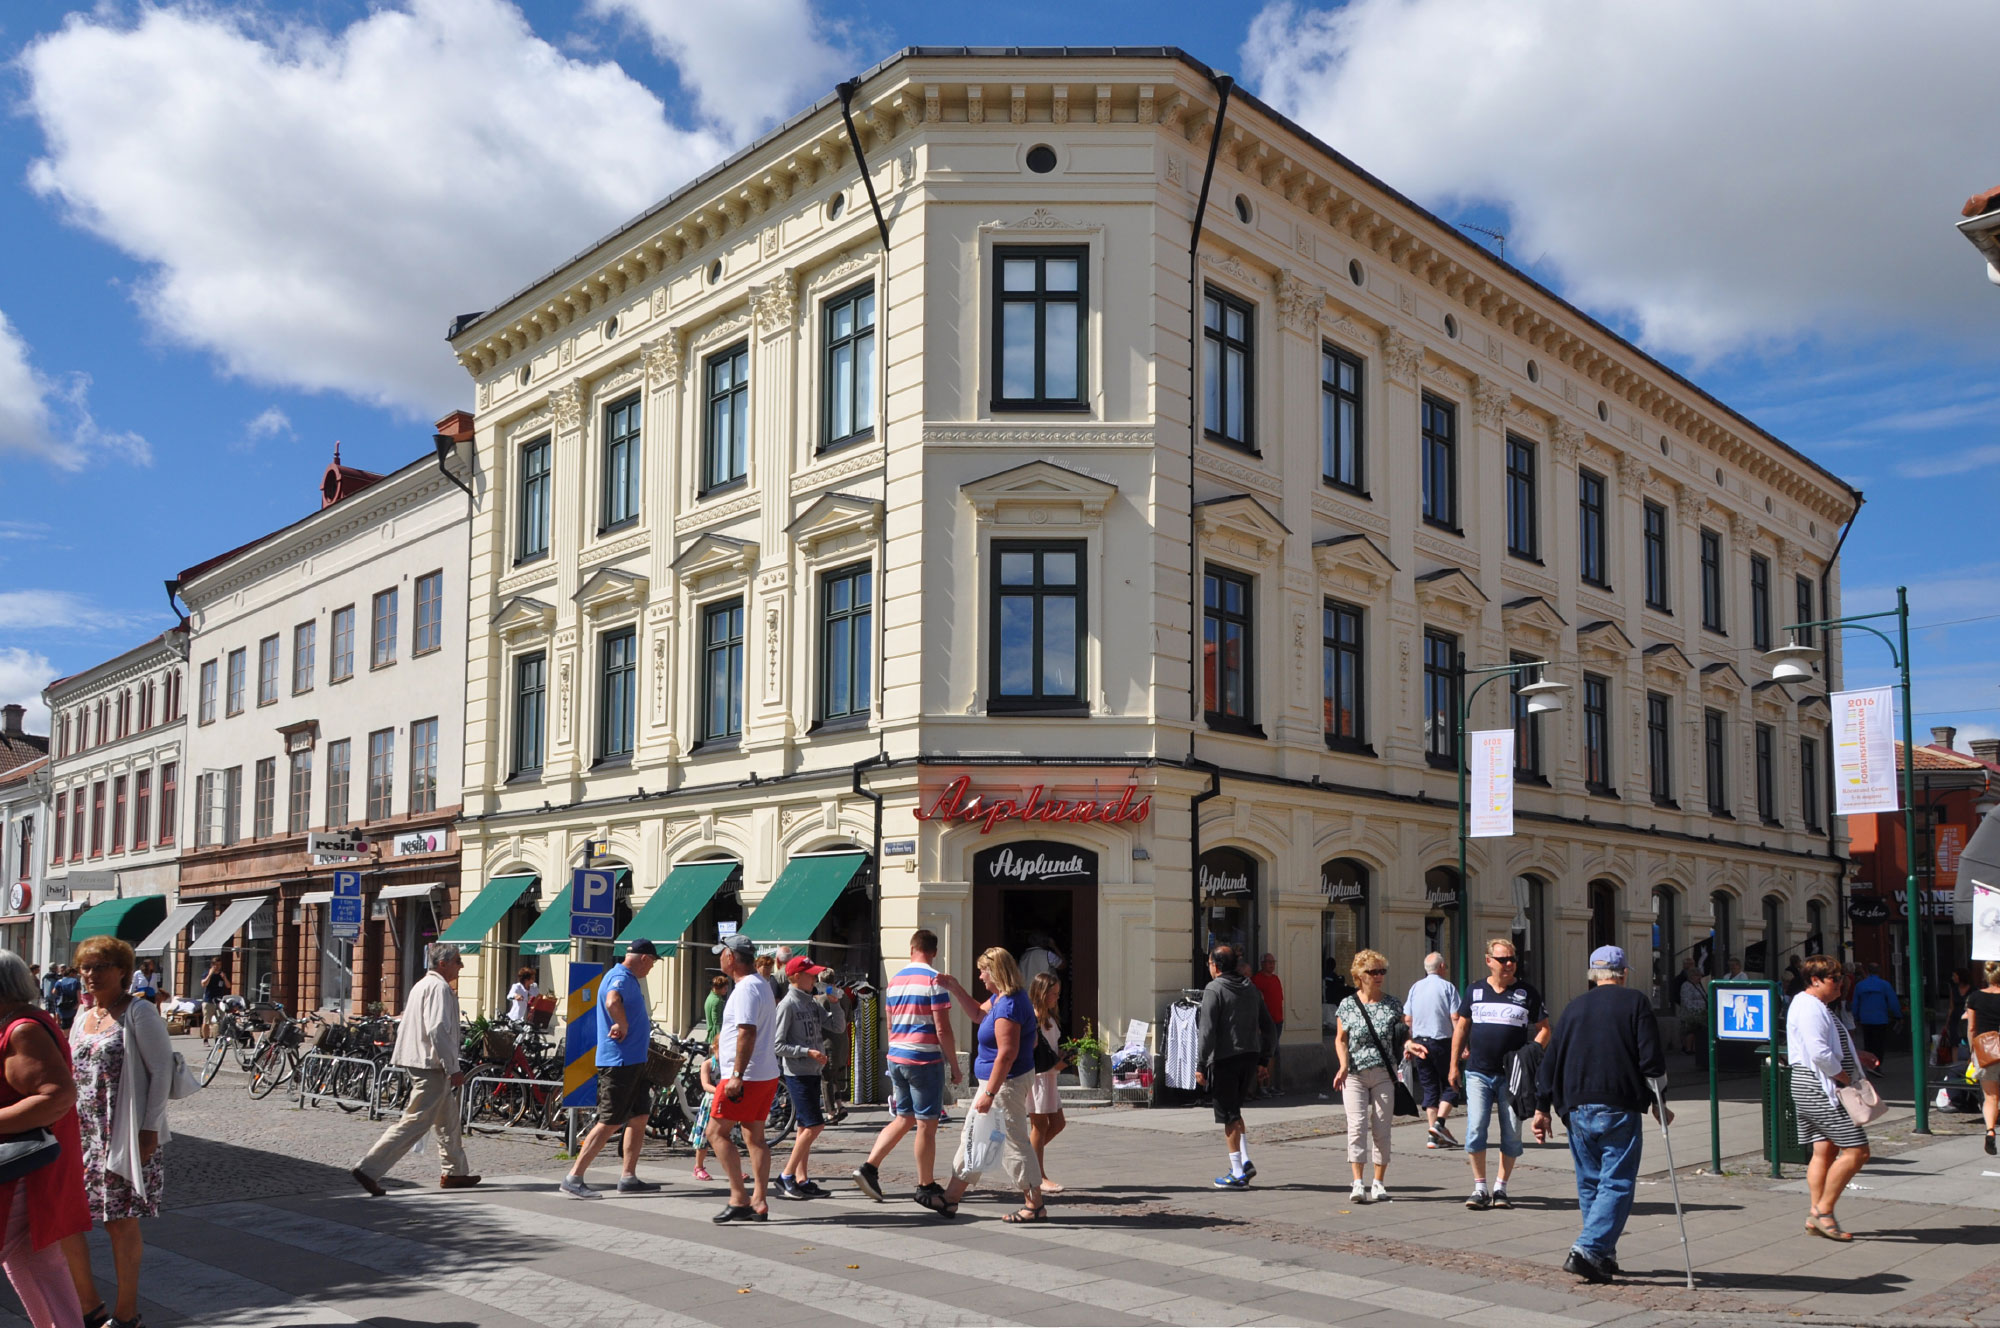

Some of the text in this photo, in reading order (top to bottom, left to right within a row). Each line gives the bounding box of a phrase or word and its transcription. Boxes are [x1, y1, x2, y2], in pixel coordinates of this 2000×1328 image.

[1848, 698, 1874, 707] 2016
[1859, 708, 1868, 784] PORSLINSFESTIVALEN
[913, 776, 1152, 834] Asplunds
[315, 838, 355, 851] resia
[990, 848, 1091, 881] Asplunds
[1199, 864, 1252, 896] Asplunds
[340, 874, 355, 894] P
[583, 873, 608, 909] P
[1428, 886, 1460, 908] splunds
